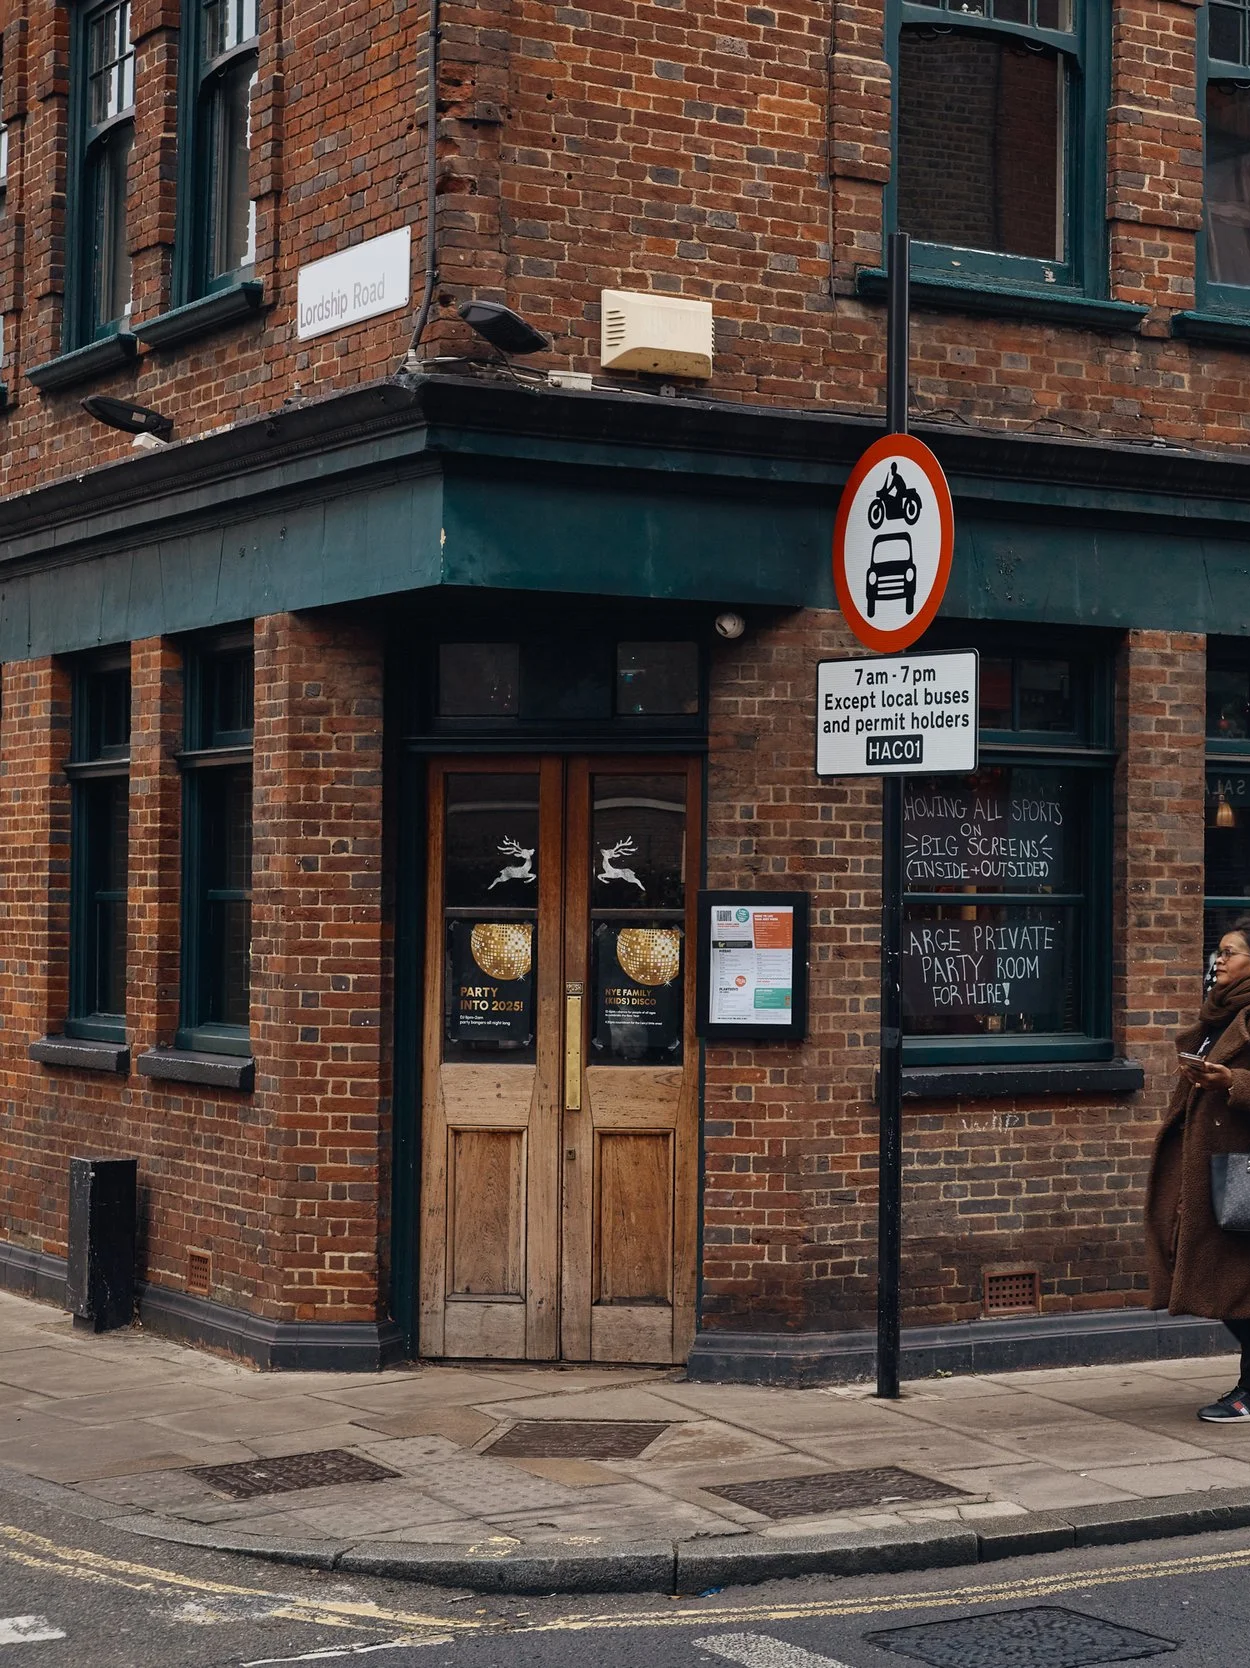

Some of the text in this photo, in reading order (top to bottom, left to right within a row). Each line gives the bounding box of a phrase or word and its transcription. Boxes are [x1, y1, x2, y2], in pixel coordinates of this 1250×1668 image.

[300, 272, 385, 329] Lordship Road
[824, 688, 969, 712] Except local buses
[823, 711, 970, 735] and permit holders
[904, 796, 1063, 825] HOWING ALL SPORTS
[960, 822, 982, 837] ON
[921, 834, 1039, 858] BIG SCREENS
[973, 925, 1055, 953] PRIVATE
[921, 953, 1040, 983] PARTY ROOM
[460, 986, 498, 997] PARTY
[605, 997, 630, 1005] (KIDS)
[622, 989, 651, 997] FAMILY
[932, 982, 1010, 1007] FOR HIRE!
[460, 1000, 523, 1011] INTO 2025!
